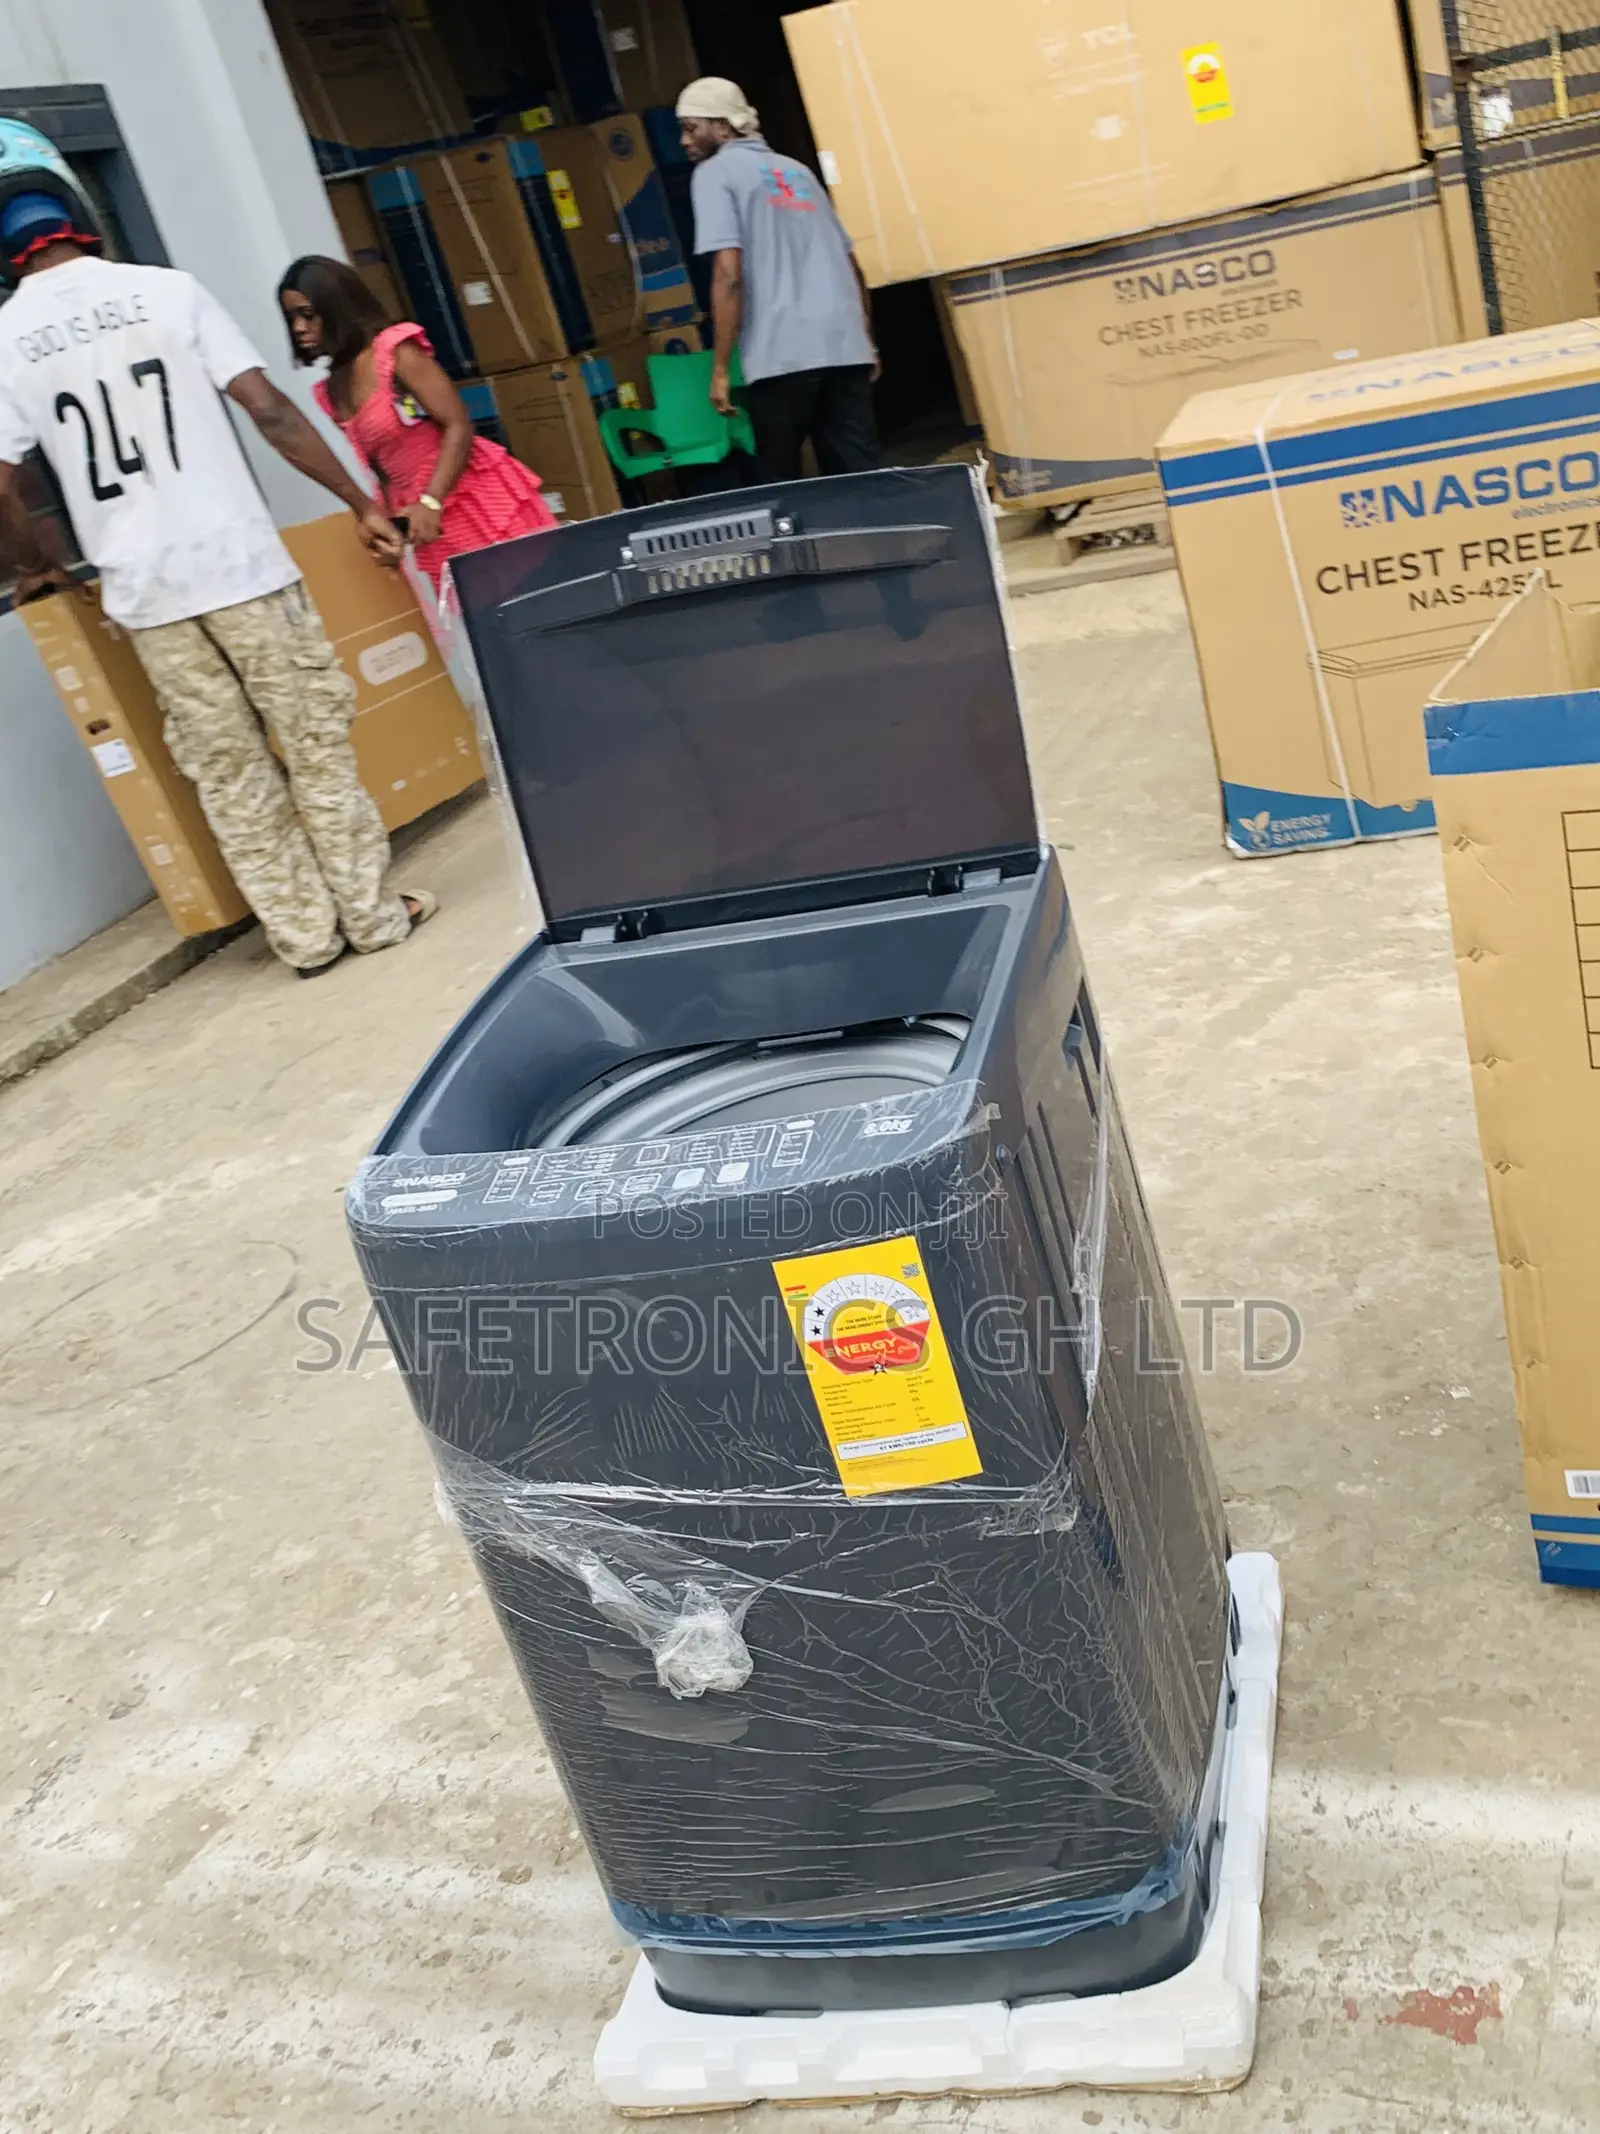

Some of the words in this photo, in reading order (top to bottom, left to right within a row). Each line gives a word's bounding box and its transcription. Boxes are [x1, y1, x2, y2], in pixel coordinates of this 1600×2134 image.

[1138, 249, 1277, 300] NASCO
[16, 324, 67, 363] GOD
[64, 316, 93, 346] IS
[92, 293, 150, 330] ABLE
[1098, 314, 1175, 346] CHEST
[1184, 289, 1304, 331] FREEZER
[55, 357, 181, 501] 247
[1380, 450, 1600, 523] NASCO
[1316, 547, 1445, 595] CHEST
[1460, 521, 1600, 572] FREEZ
[1408, 568, 1564, 612] NAS-425L
[826, 1337, 898, 1359] ENERGY
